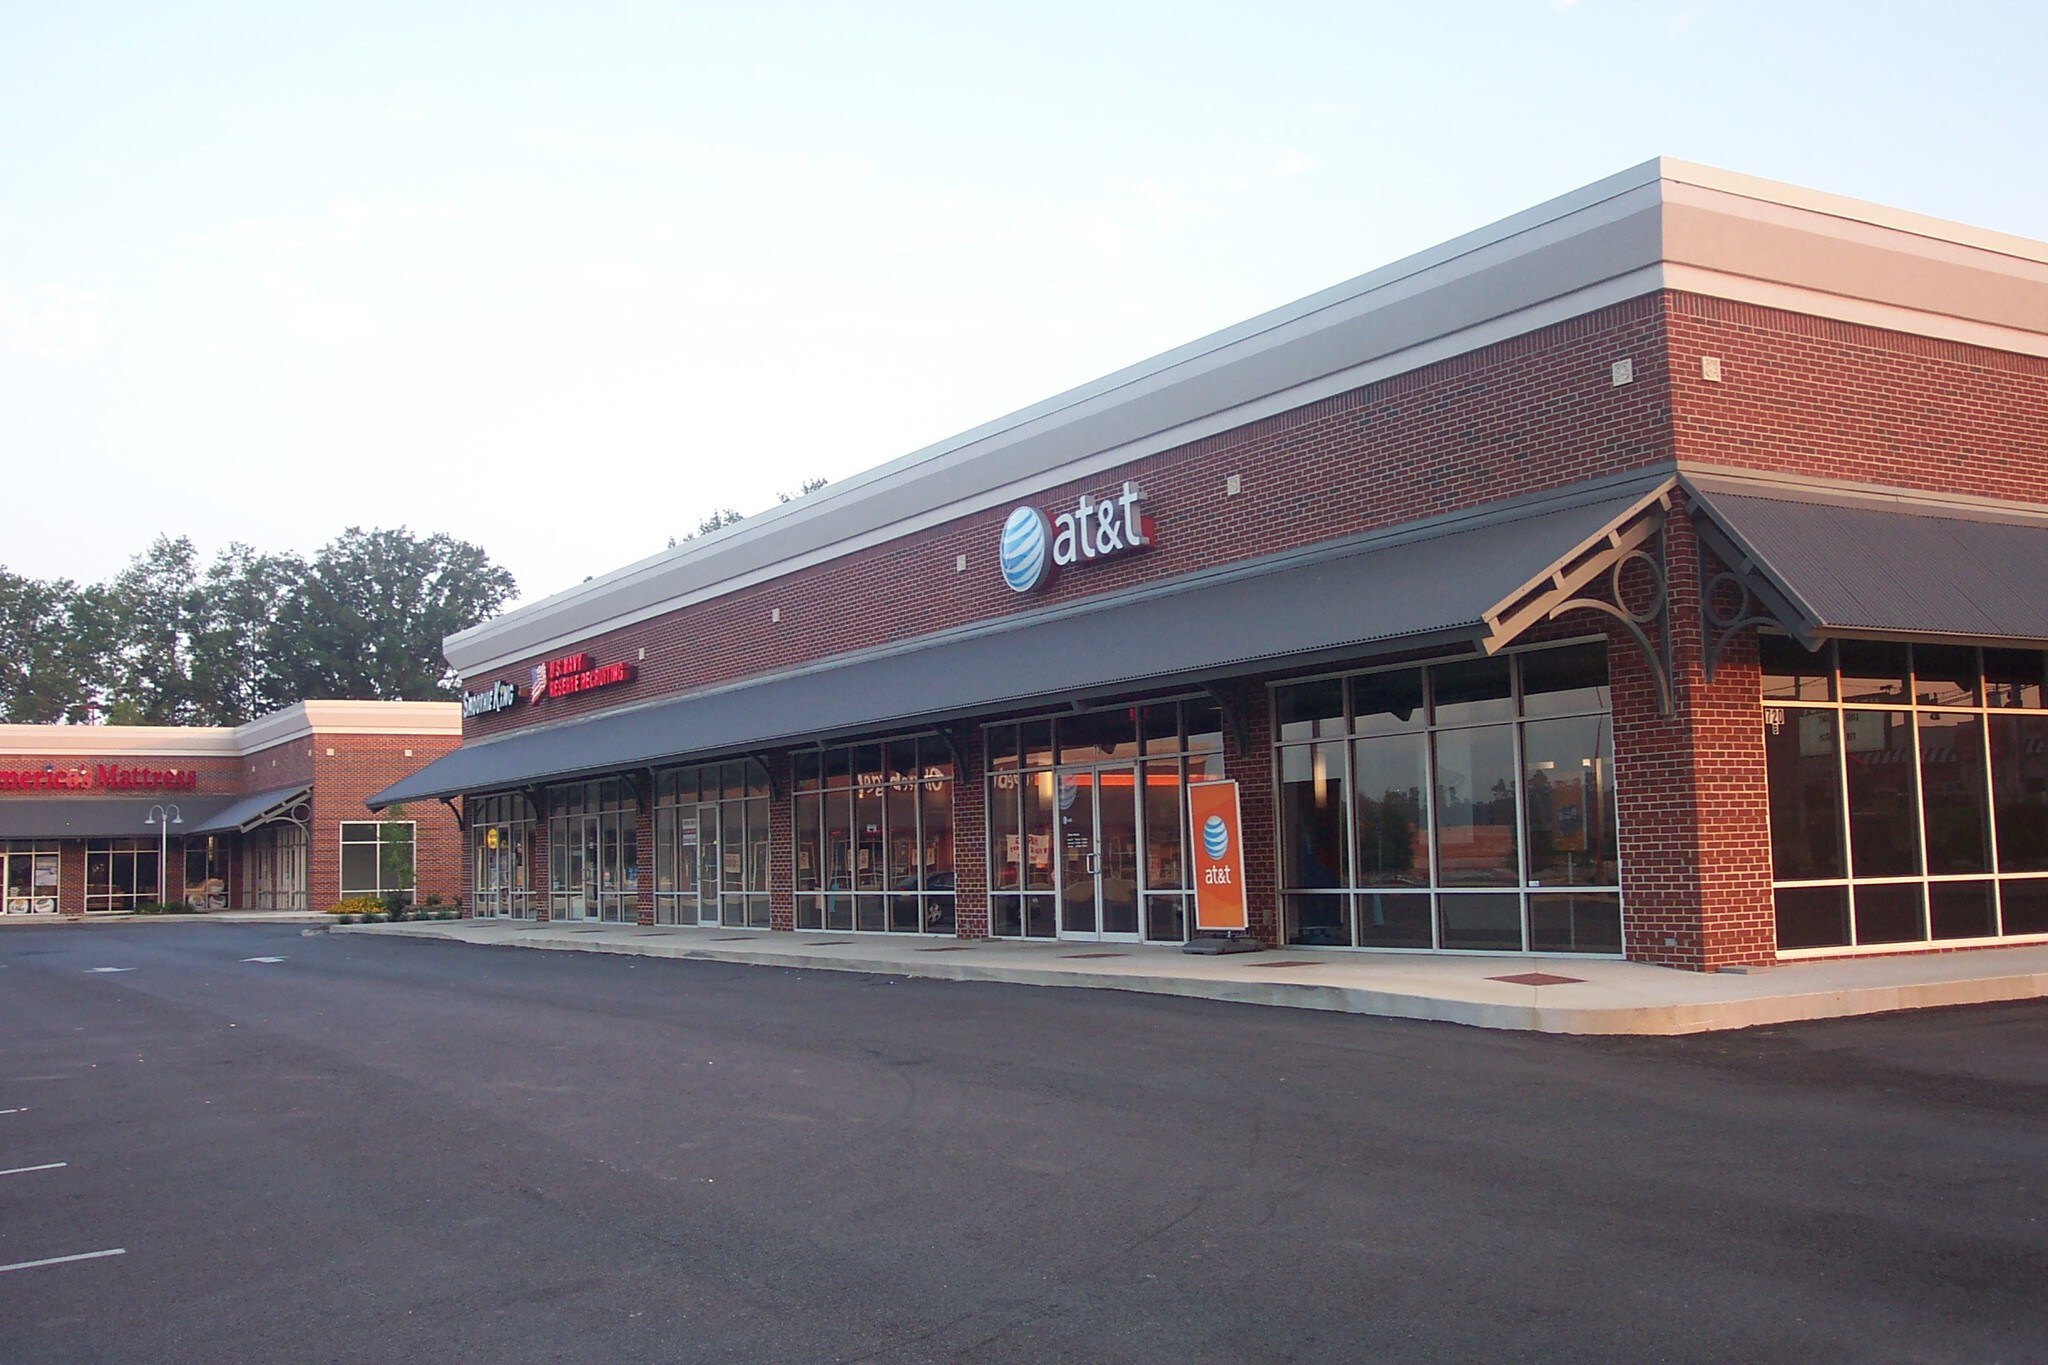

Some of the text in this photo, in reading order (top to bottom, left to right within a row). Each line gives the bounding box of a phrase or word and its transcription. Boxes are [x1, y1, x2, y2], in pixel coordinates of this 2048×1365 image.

[1053, 481, 1141, 566] at&t
[563, 653, 583, 675] NAVY
[549, 662, 624, 698] RESERVE RECRUITING
[1766, 708, 1783, 723] 720
[0, 764, 197, 790] merica's Mattress
[1204, 865, 1232, 885] at&t
